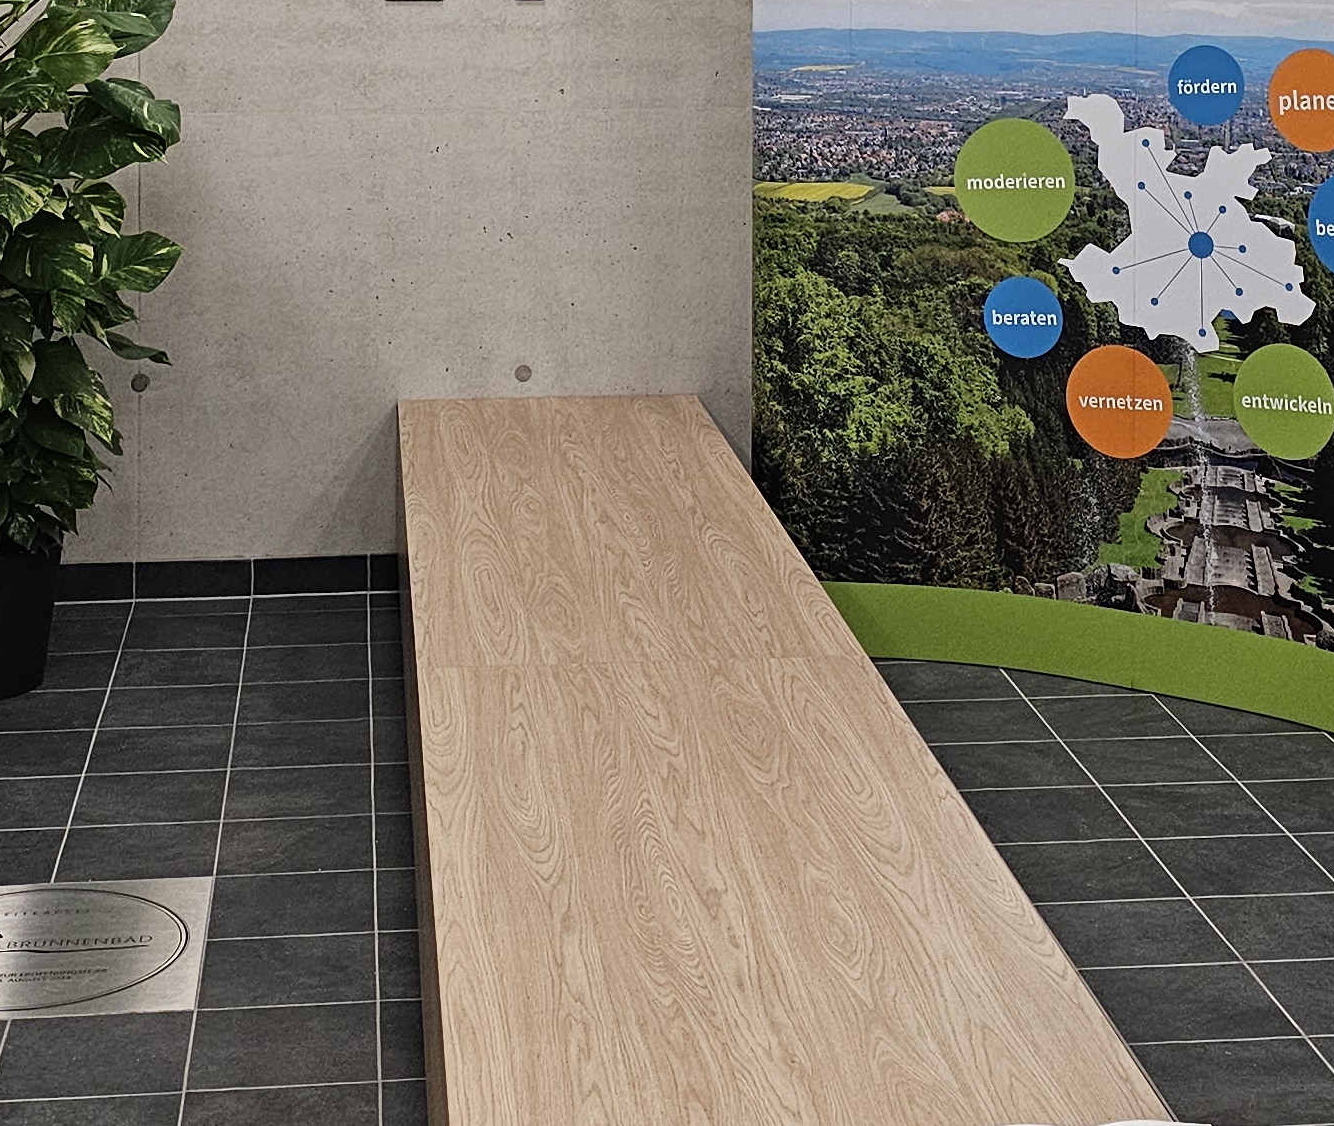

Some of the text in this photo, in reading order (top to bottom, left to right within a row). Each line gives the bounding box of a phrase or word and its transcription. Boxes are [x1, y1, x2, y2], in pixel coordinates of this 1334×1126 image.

[1176, 78, 1238, 95] fördern
[967, 174, 1066, 191] moderieren
[991, 310, 1058, 327] beraten
[1078, 394, 1164, 413] vernetzen
[1241, 393, 1333, 416] entwickeln
